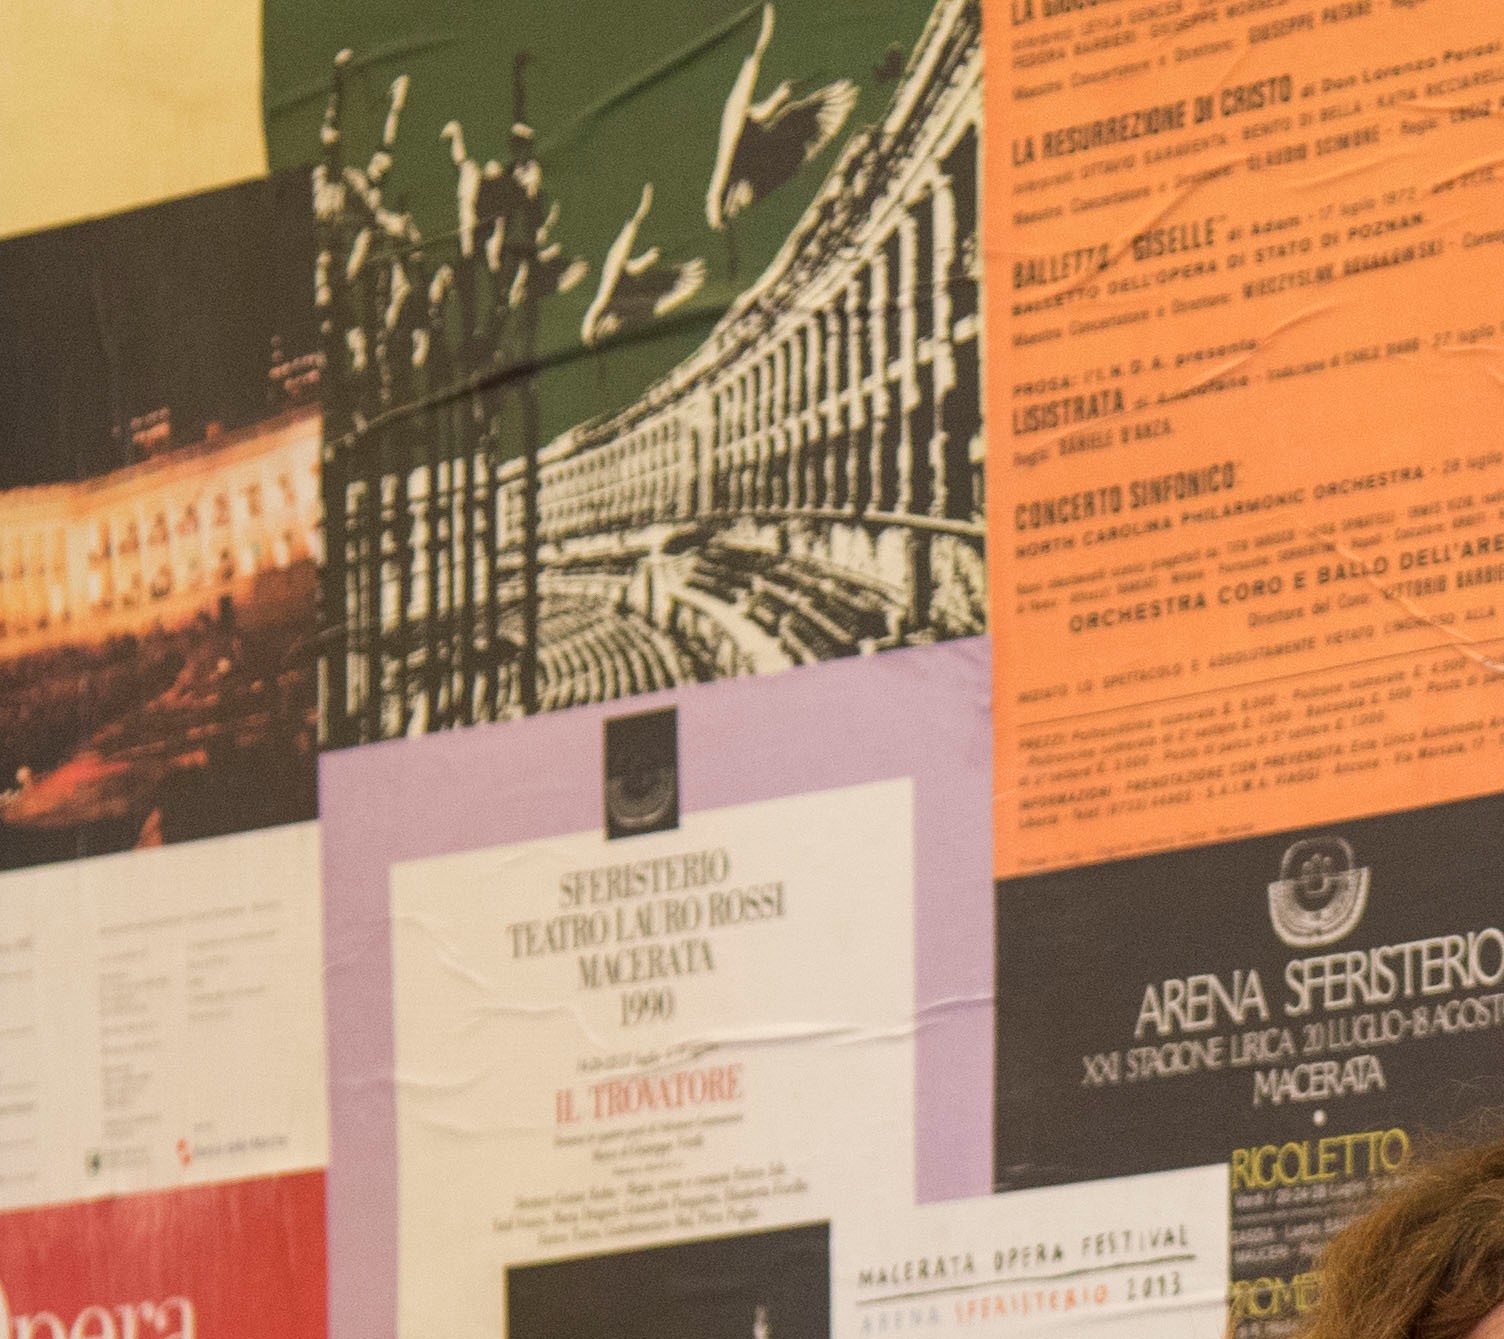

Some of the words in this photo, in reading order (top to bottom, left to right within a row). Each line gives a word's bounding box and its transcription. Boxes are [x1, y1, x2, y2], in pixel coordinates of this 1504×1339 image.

[1012, 136, 1035, 167] LA
[1042, 101, 1186, 160] RESURREZIONE
[1220, 73, 1292, 117] CRISTO
[1012, 387, 1125, 437] LISISTRATA
[1015, 485, 1122, 532] CONCERTO
[1069, 591, 1207, 634] ORCHESTRA
[1217, 576, 1282, 607] CORO
[1317, 556, 1389, 586] BALLO
[558, 847, 730, 909] SFERISTERIO
[505, 915, 607, 960] TEATRO
[615, 899, 702, 944] LAURO
[707, 880, 785, 929] ROSSI
[577, 939, 715, 991] MACERATA
[620, 987, 674, 1029] 1990
[1134, 969, 1270, 1040] ARENA
[1080, 1053, 1118, 1088] XXI
[1126, 1035, 1223, 1081] STAGIONE
[1230, 1029, 1295, 1068] LIRICA
[1252, 1054, 1386, 1107] MACERATA
[595, 1063, 744, 1123] TROVATORE
[1231, 1127, 1411, 1191] RIGOLETTO
[858, 1253, 974, 1288] MACERATA
[994, 1243, 1064, 1272] OPERA
[1081, 1223, 1190, 1258] FESTIVAL
[1127, 1271, 1183, 1302] 2013
